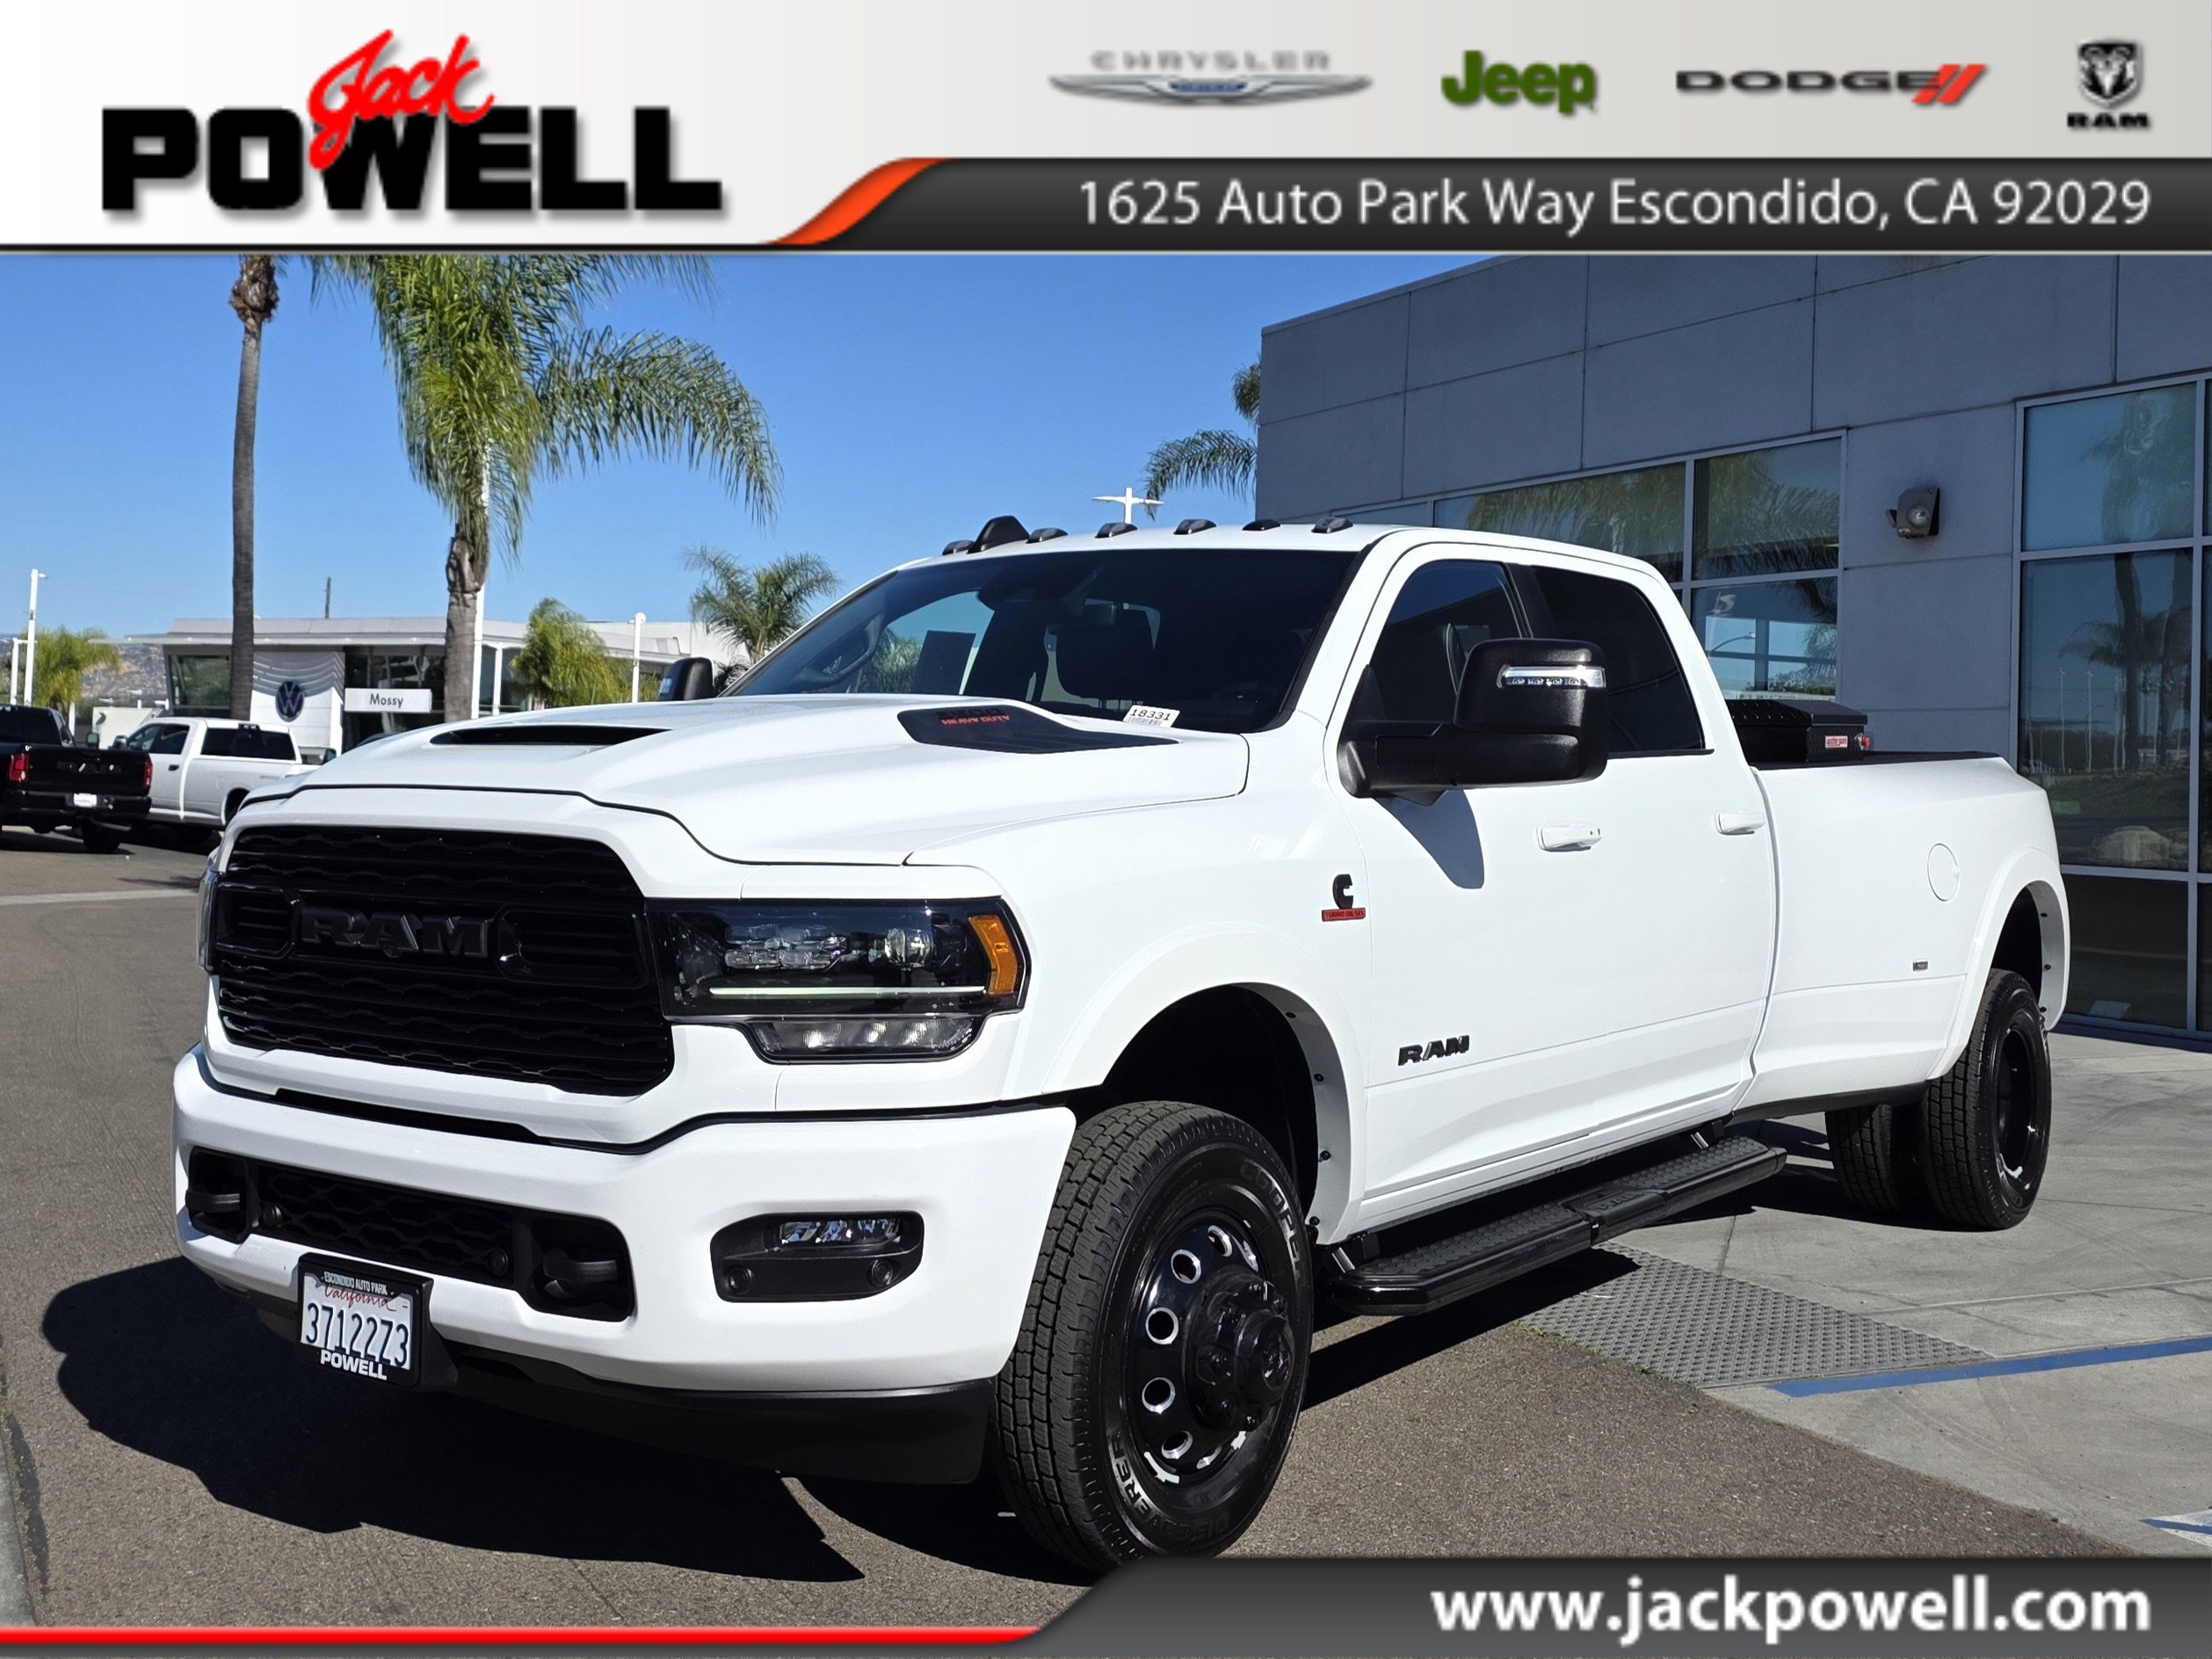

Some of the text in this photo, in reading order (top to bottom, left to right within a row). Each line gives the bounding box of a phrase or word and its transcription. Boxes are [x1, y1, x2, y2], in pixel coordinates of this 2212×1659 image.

[369, 693, 404, 709] Mossy
[1130, 708, 1171, 721] 18331
[301, 907, 489, 958] RAM
[1397, 1034, 1469, 1067] RAM
[323, 1271, 388, 1295] ESCONDIDO AUTO PARK
[324, 1284, 397, 1312] California
[306, 1301, 409, 1368] 3712273
[320, 1349, 388, 1380] POWELL
